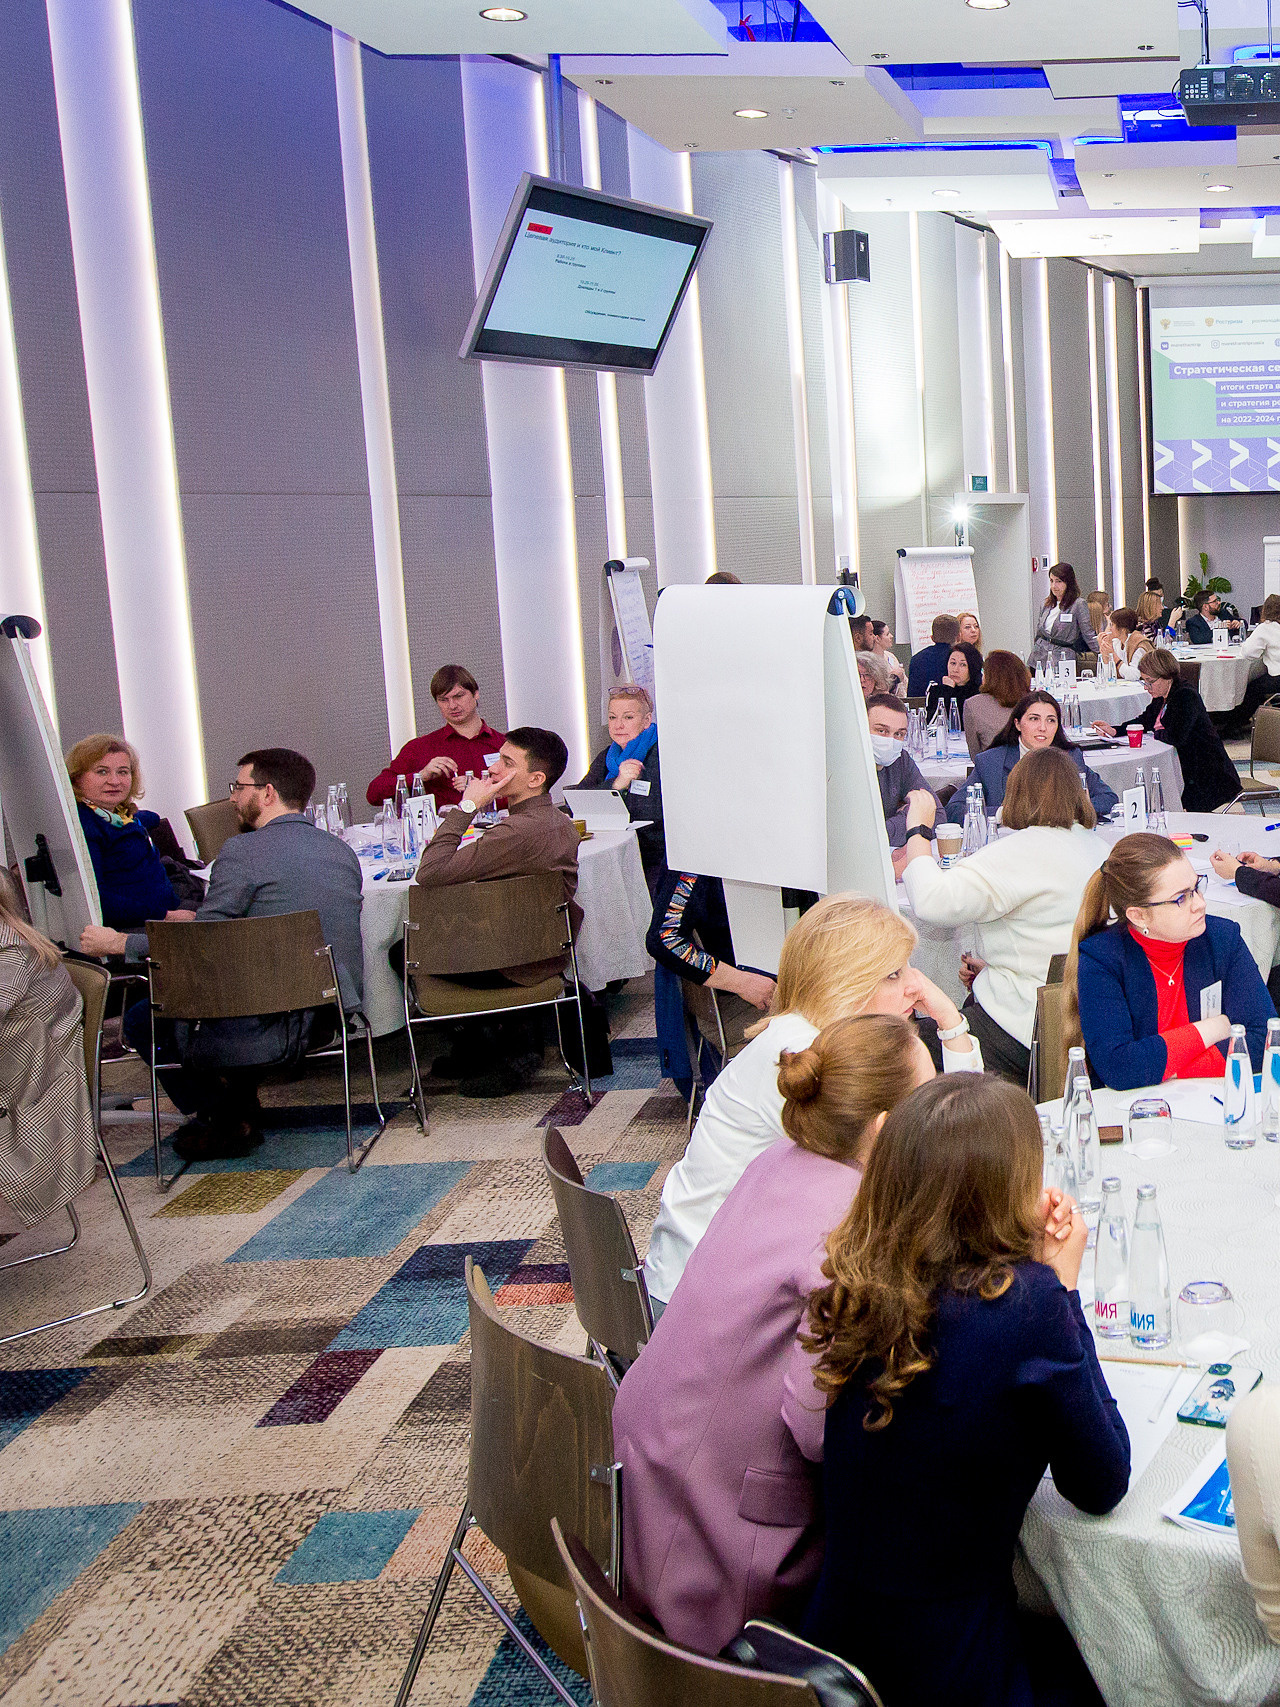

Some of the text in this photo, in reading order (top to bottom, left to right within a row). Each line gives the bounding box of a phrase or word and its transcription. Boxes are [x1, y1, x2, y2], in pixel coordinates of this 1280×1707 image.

[1173, 363, 1265, 376] Стратегическая
[1220, 383, 1244, 391] итоги
[1246, 382, 1273, 391] старта
[1228, 399, 1270, 408] стратегия
[1064, 667, 1070, 678] 3
[1130, 801, 1138, 819] 2
